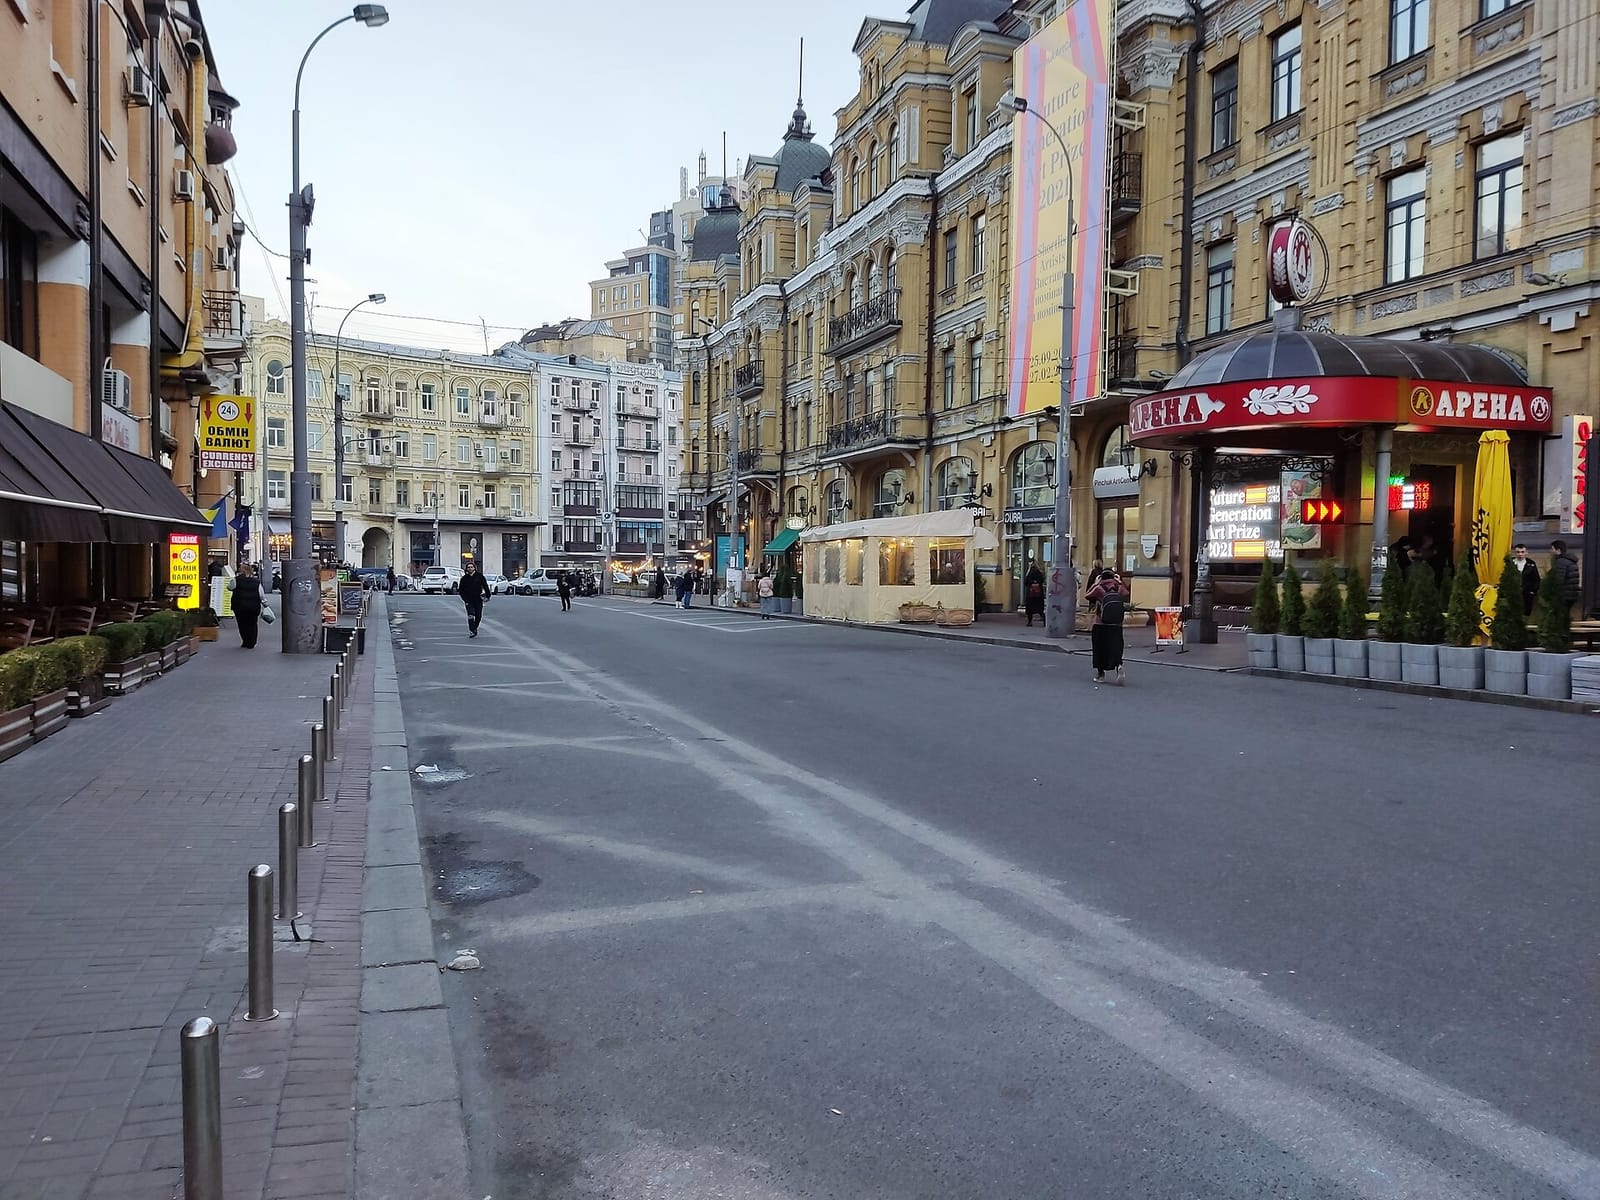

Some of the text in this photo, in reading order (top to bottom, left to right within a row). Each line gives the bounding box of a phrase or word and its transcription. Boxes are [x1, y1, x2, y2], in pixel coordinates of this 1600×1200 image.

[1024, 104, 1095, 161] Gneration
[1040, 174, 1068, 210] 2021
[1436, 390, 1526, 421] АРЕНА
[208, 425, 249, 437] ОБМІН
[206, 437, 251, 448] ВАЛЮТ
[201, 451, 254, 461] CURRENCY
[202, 460, 254, 470] EXCHANGE
[1094, 475, 1137, 487] PinchukArtCent
[1004, 511, 1023, 523] DUBAI
[1209, 504, 1272, 523] Generation
[1227, 522, 1261, 540] Prize
